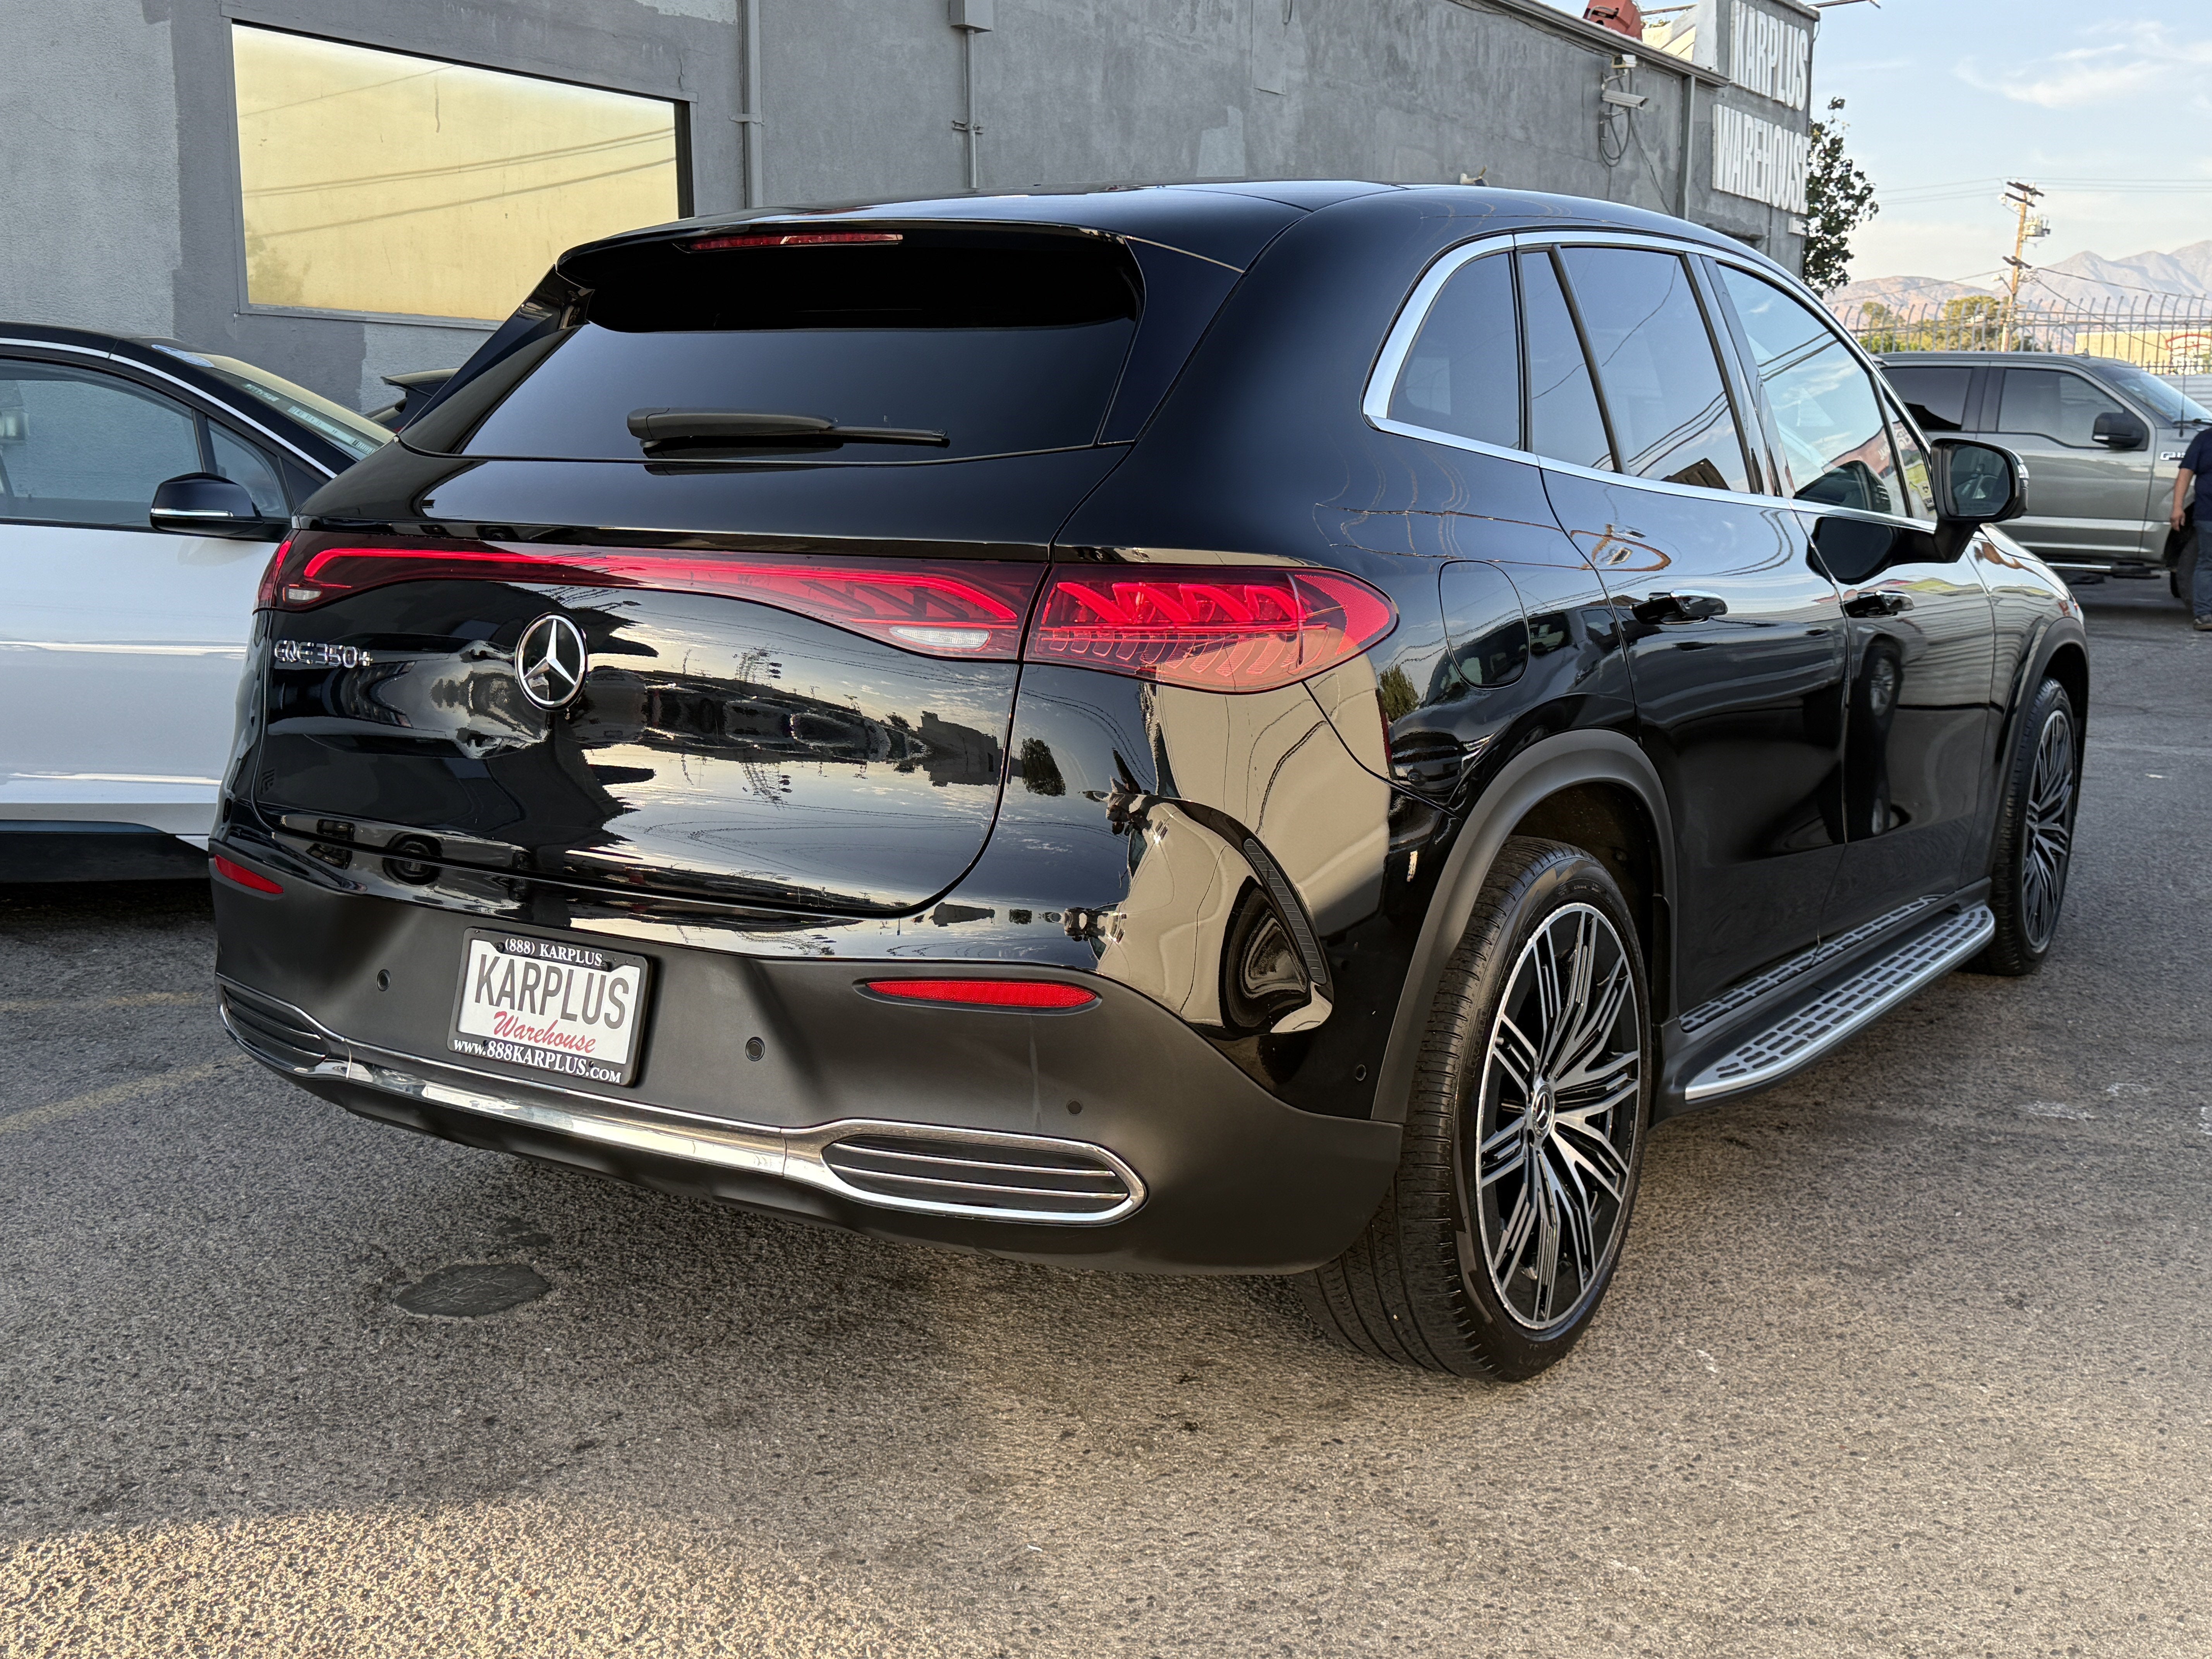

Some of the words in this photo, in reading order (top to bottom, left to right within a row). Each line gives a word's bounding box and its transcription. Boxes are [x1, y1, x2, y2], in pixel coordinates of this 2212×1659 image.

[1730, 0, 1808, 111] KARPLUS
[1712, 104, 1811, 215] WAREHOUSE
[504, 938, 535, 955] (888)
[539, 943, 603, 967] KARPLUS
[474, 954, 629, 1030] KARPLUS
[493, 1011, 596, 1053] Warehouse
